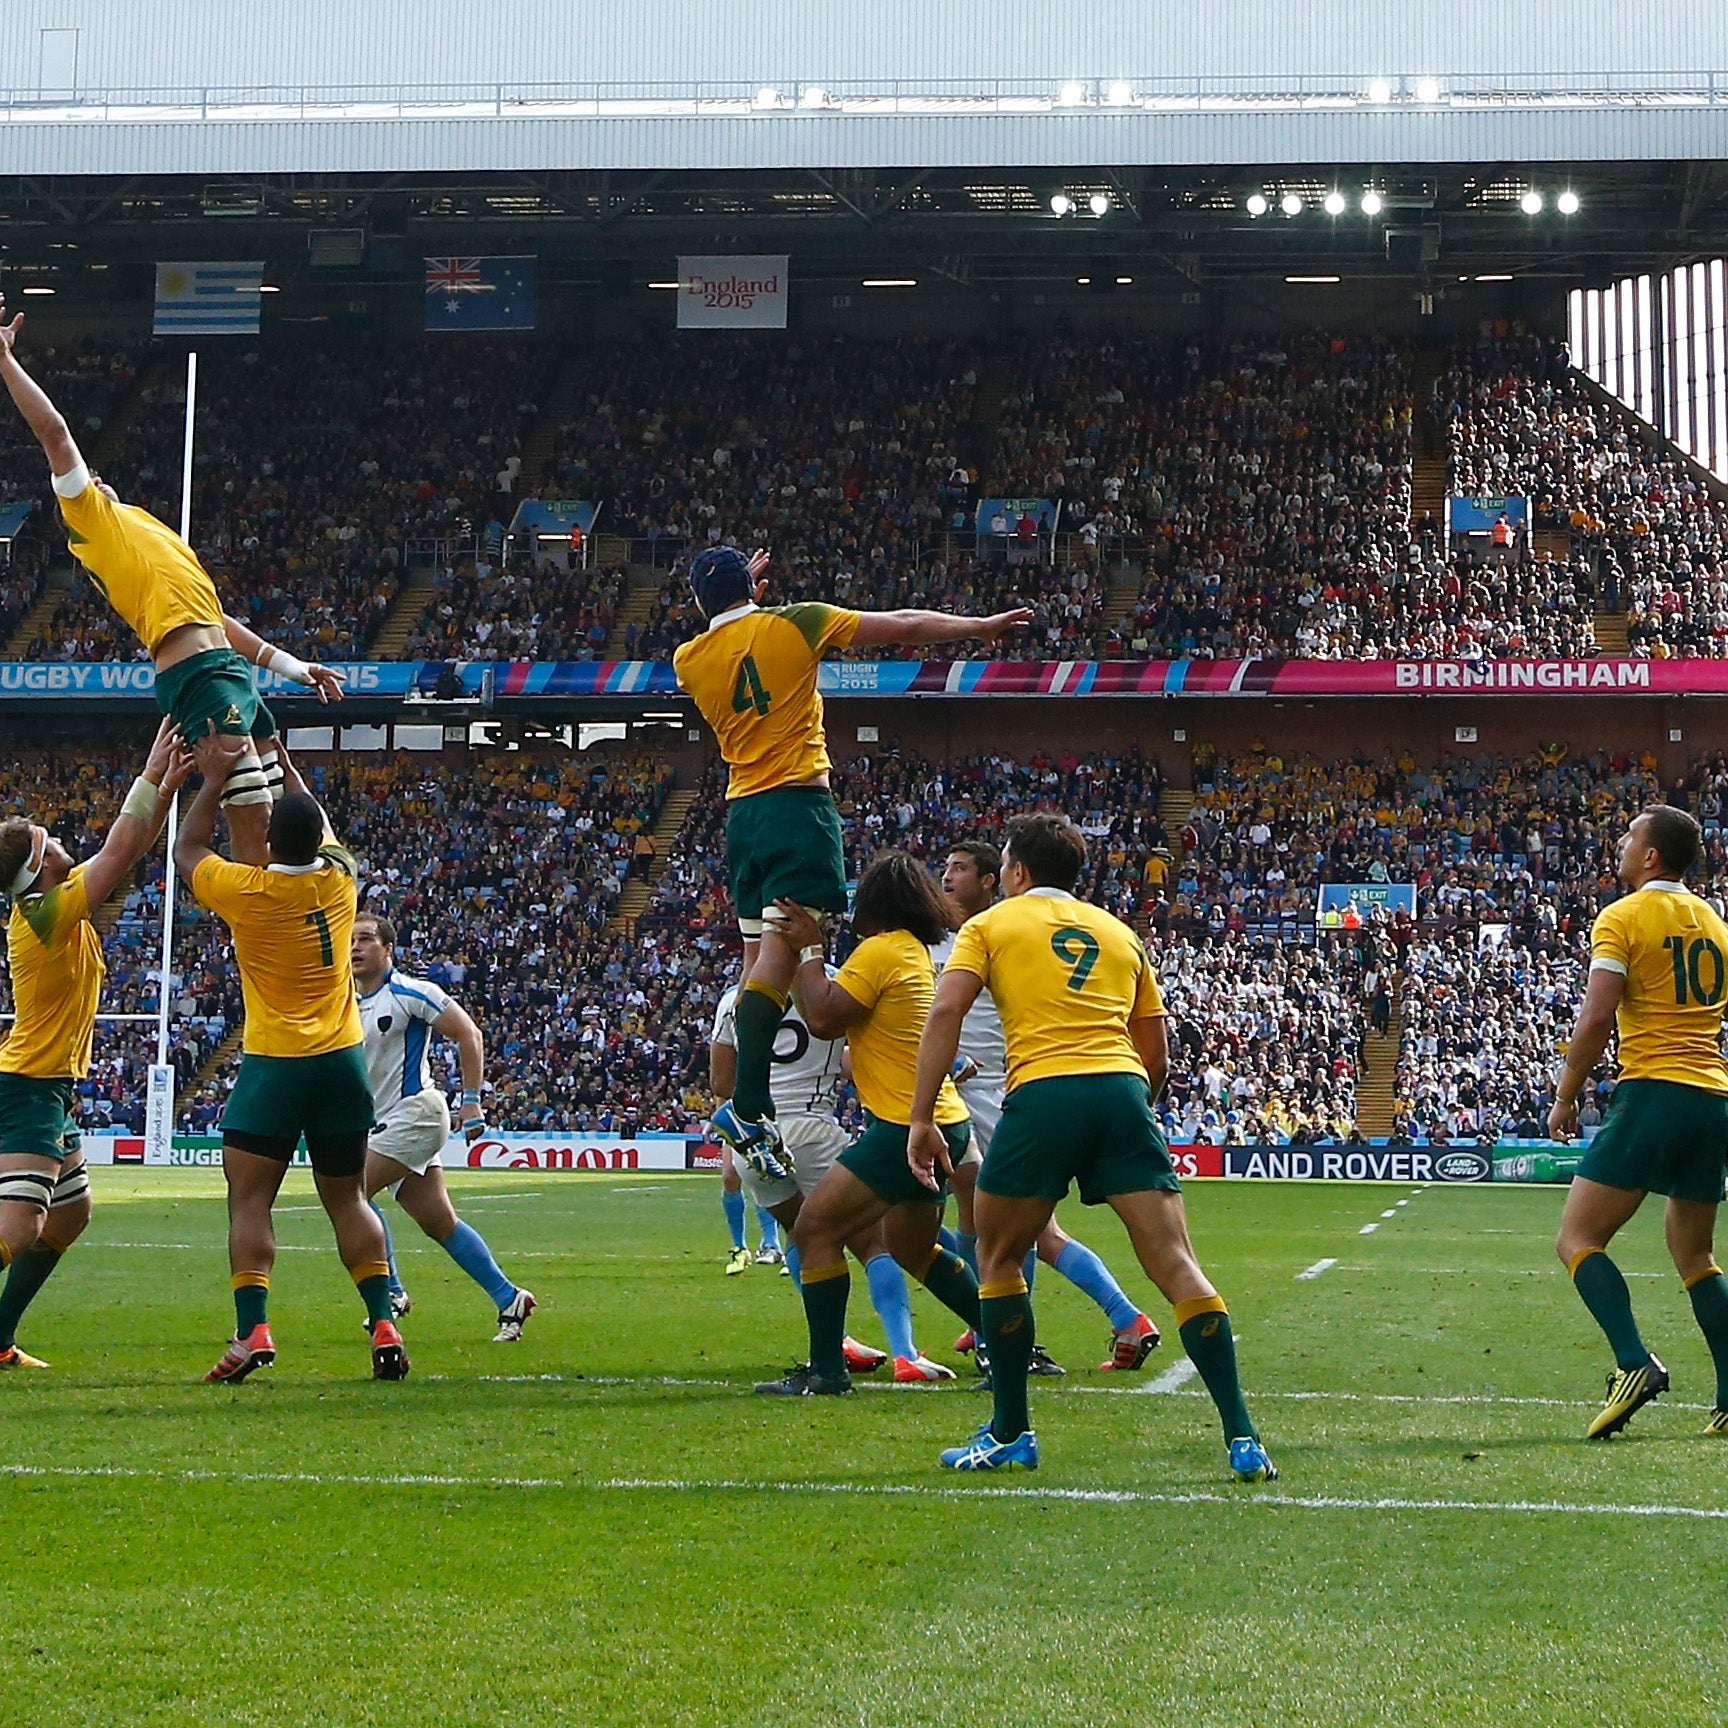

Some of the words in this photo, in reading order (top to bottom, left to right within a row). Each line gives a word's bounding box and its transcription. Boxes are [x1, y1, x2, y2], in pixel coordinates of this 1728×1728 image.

[688, 276, 778, 294] England
[705, 293, 755, 309] 2015
[842, 663, 879, 673] RUGBY
[1396, 663, 1650, 687] BIRMINGHAM
[732, 655, 772, 716] 4
[841, 679, 878, 689] 2015
[305, 909, 334, 967] 1
[1051, 927, 1100, 992] 9
[1662, 936, 1724, 1007] 10
[467, 1141, 639, 1169] Canon
[1224, 1152, 1312, 1178] LAND
[1323, 1153, 1434, 1180] ROVER
[1447, 1159, 1471, 1167] LAND
[1449, 1166, 1480, 1175] ROVER
